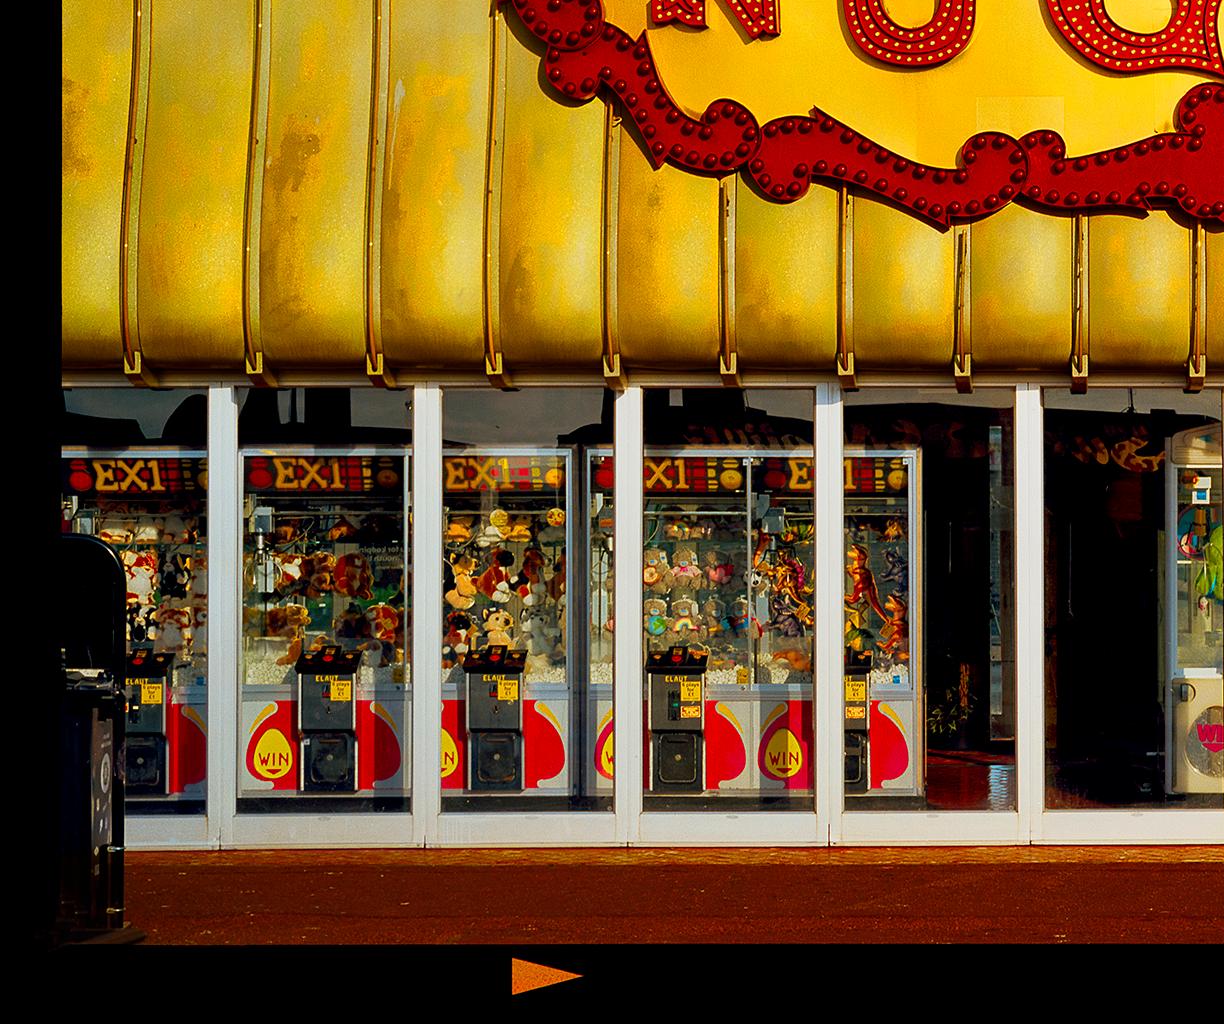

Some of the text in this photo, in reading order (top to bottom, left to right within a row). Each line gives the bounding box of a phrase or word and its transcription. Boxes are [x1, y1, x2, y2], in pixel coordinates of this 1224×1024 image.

[644, 457, 690, 489] X1
[1197, 723, 1224, 743] WI
[258, 752, 289, 766] WIN
[768, 751, 799, 766] WIN
